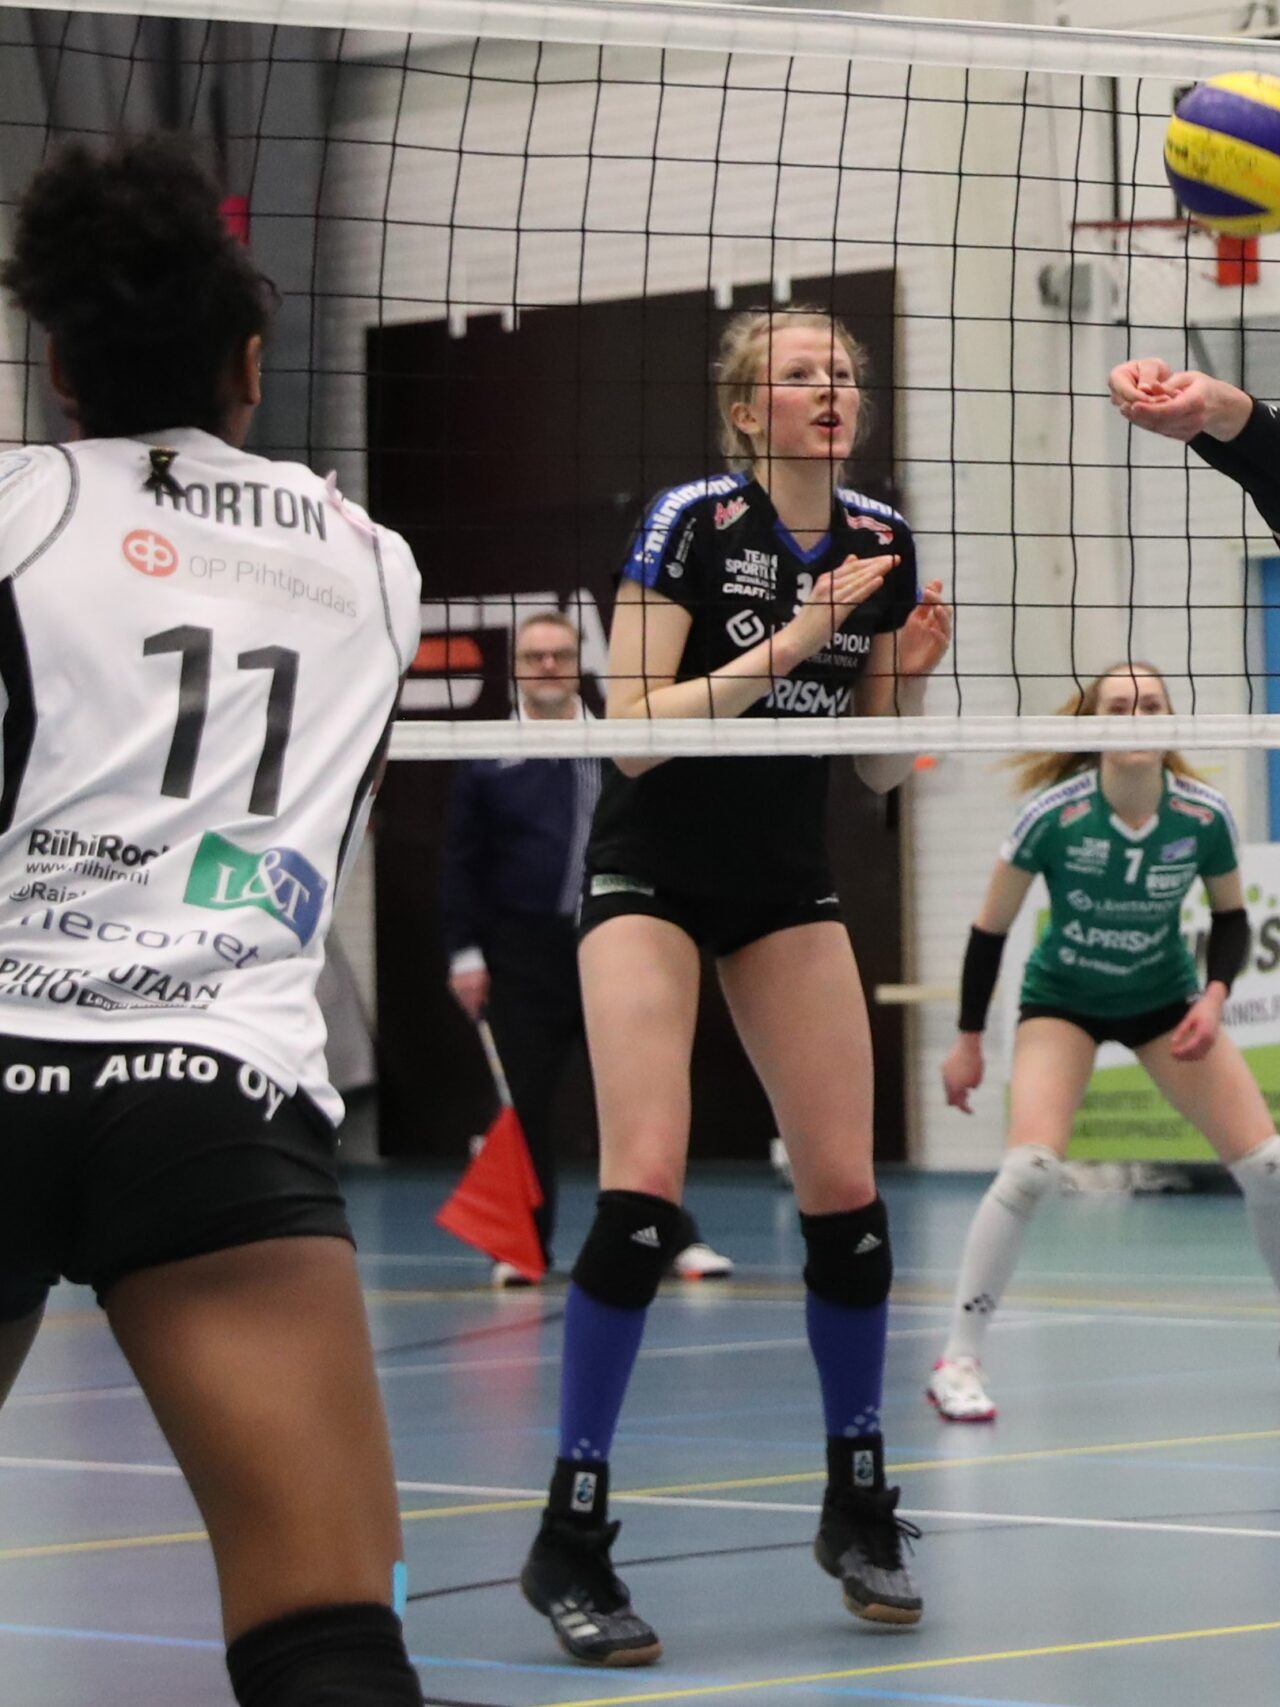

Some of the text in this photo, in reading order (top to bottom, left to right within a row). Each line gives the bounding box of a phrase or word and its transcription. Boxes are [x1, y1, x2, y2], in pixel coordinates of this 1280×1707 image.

[189, 555, 357, 618] OP Pihtipudas
[723, 583, 766, 598] CRAFT
[143, 624, 300, 817] 11
[1123, 848, 1144, 884] 7
[95, 1046, 219, 1089] Auto
